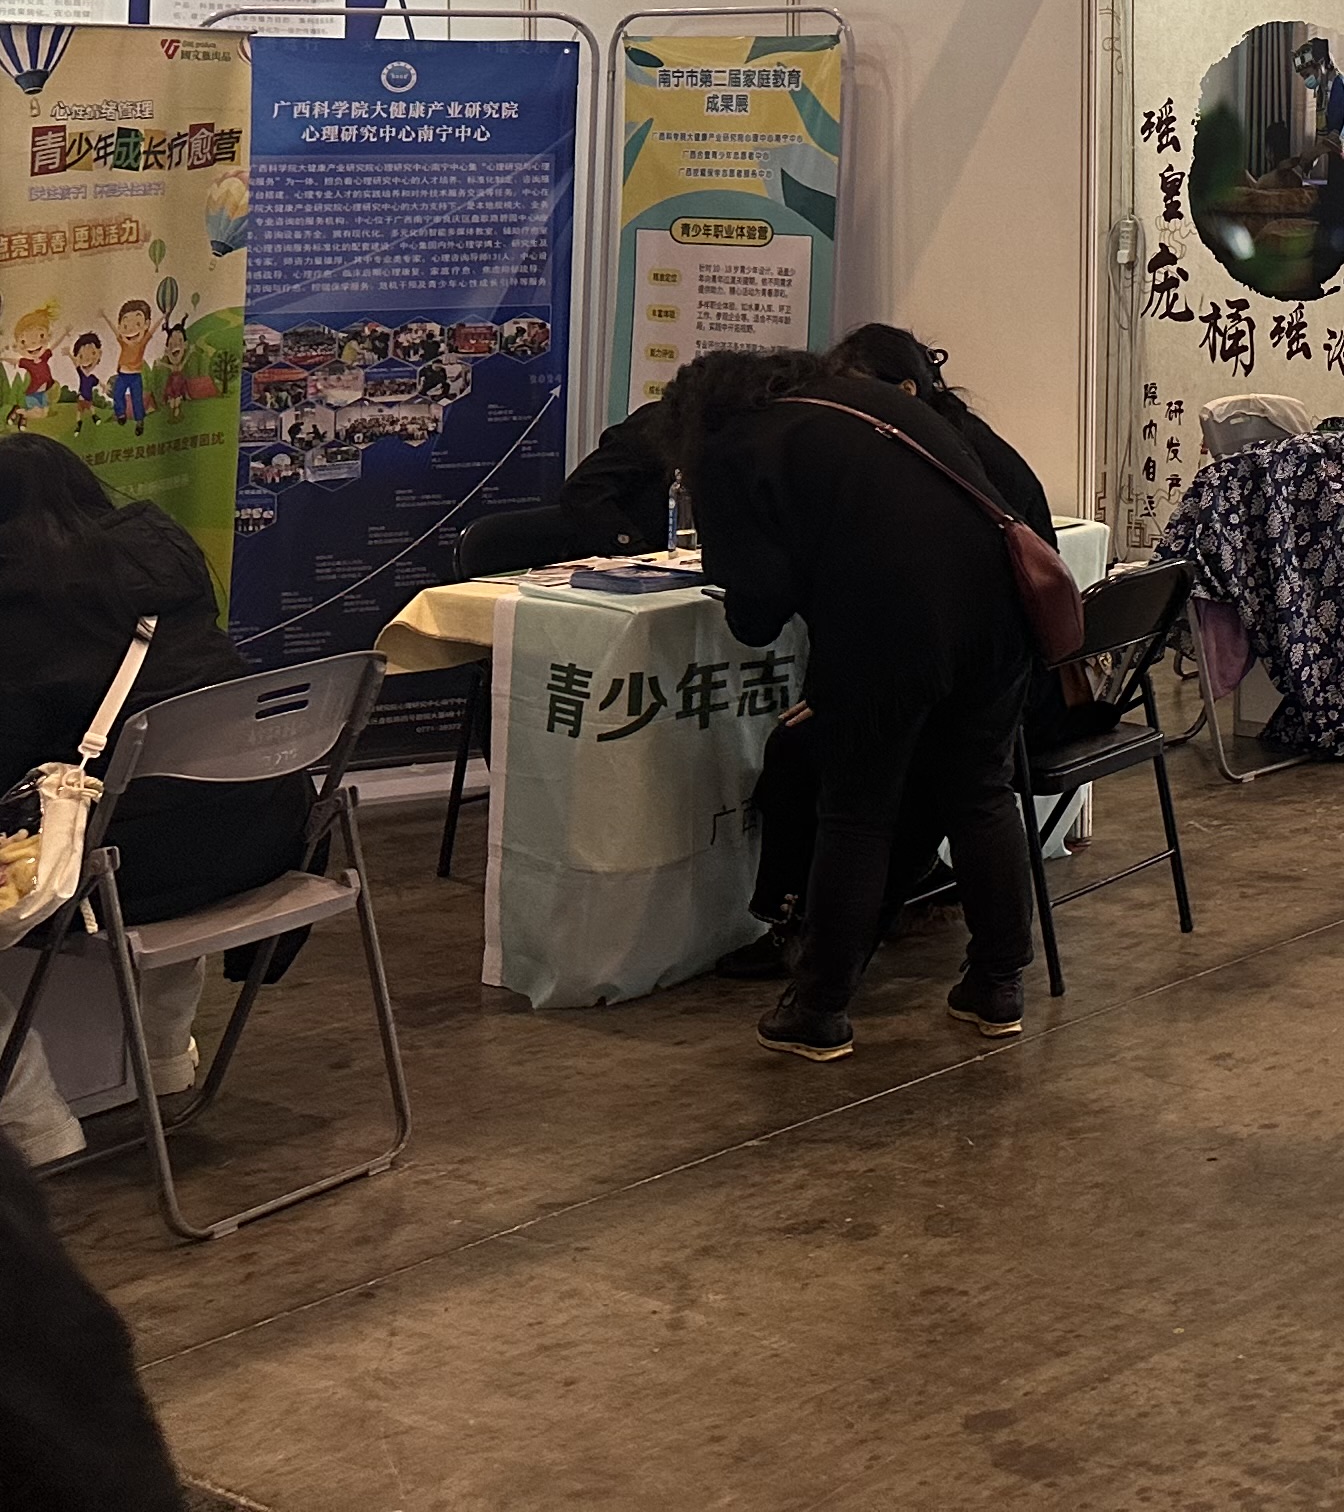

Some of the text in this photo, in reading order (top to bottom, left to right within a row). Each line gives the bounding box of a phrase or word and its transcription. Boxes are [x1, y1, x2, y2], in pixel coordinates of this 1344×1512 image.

[658, 69, 801, 88] 南宁市第二届家庭教育
[272, 100, 520, 120] 广西科学院大健康产业研究院
[705, 94, 749, 113] 成果展
[301, 125, 491, 143] 心理研究中心南宁中心
[31, 126, 243, 174] 青少年成长疗愈营
[680, 223, 768, 240] 青少年职业体验营
[547, 649, 796, 743] 青少年志
